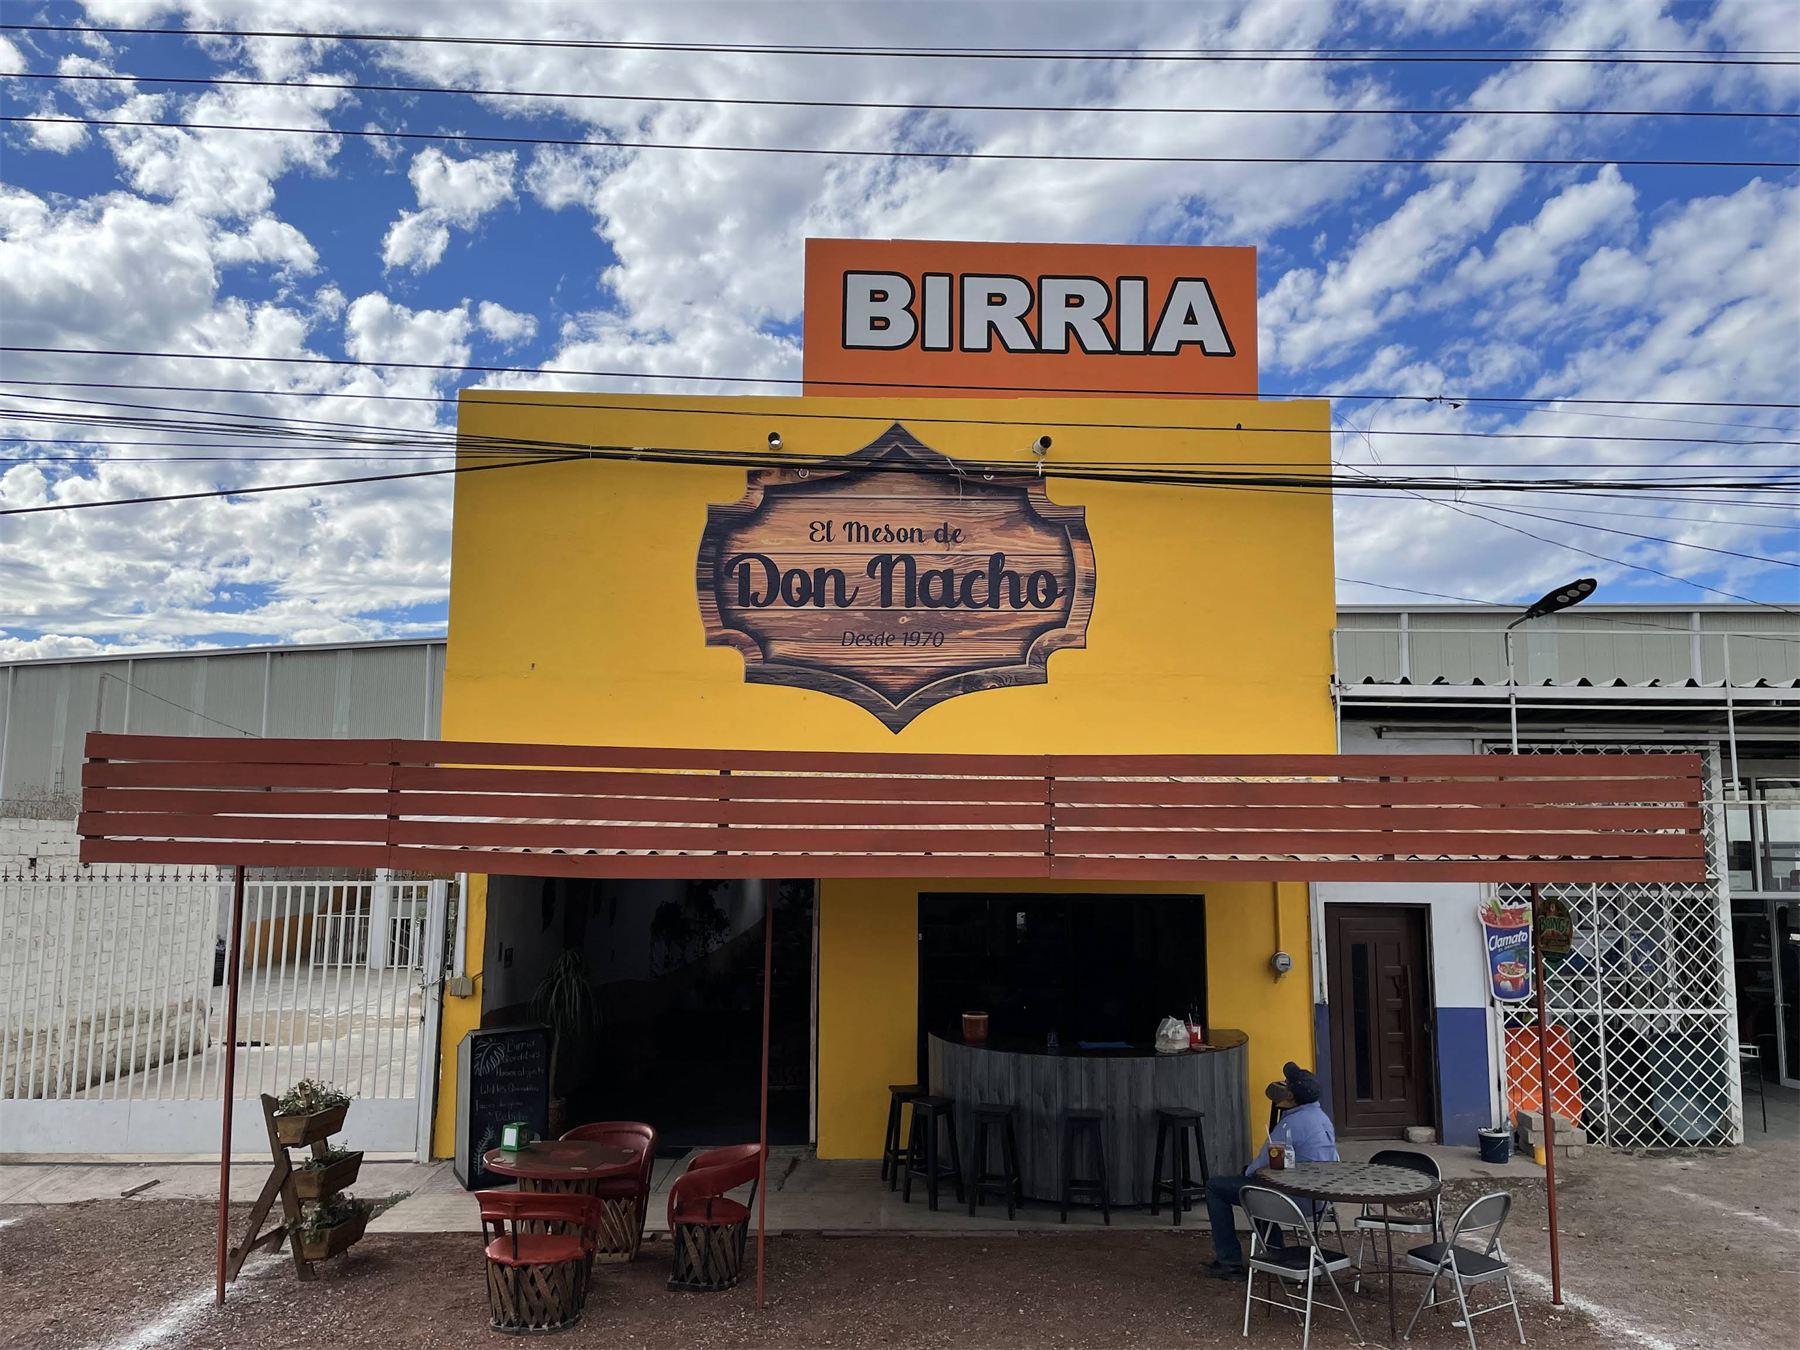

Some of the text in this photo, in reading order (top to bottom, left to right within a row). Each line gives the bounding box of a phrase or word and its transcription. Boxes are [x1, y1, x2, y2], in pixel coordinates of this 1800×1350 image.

[842, 270, 1236, 357] BIRRIA
[809, 520, 966, 544] El Meson de
[724, 552, 1066, 609] Don Nacho
[841, 631, 944, 648] Desde 1970
[1488, 930, 1528, 951] Clamato
